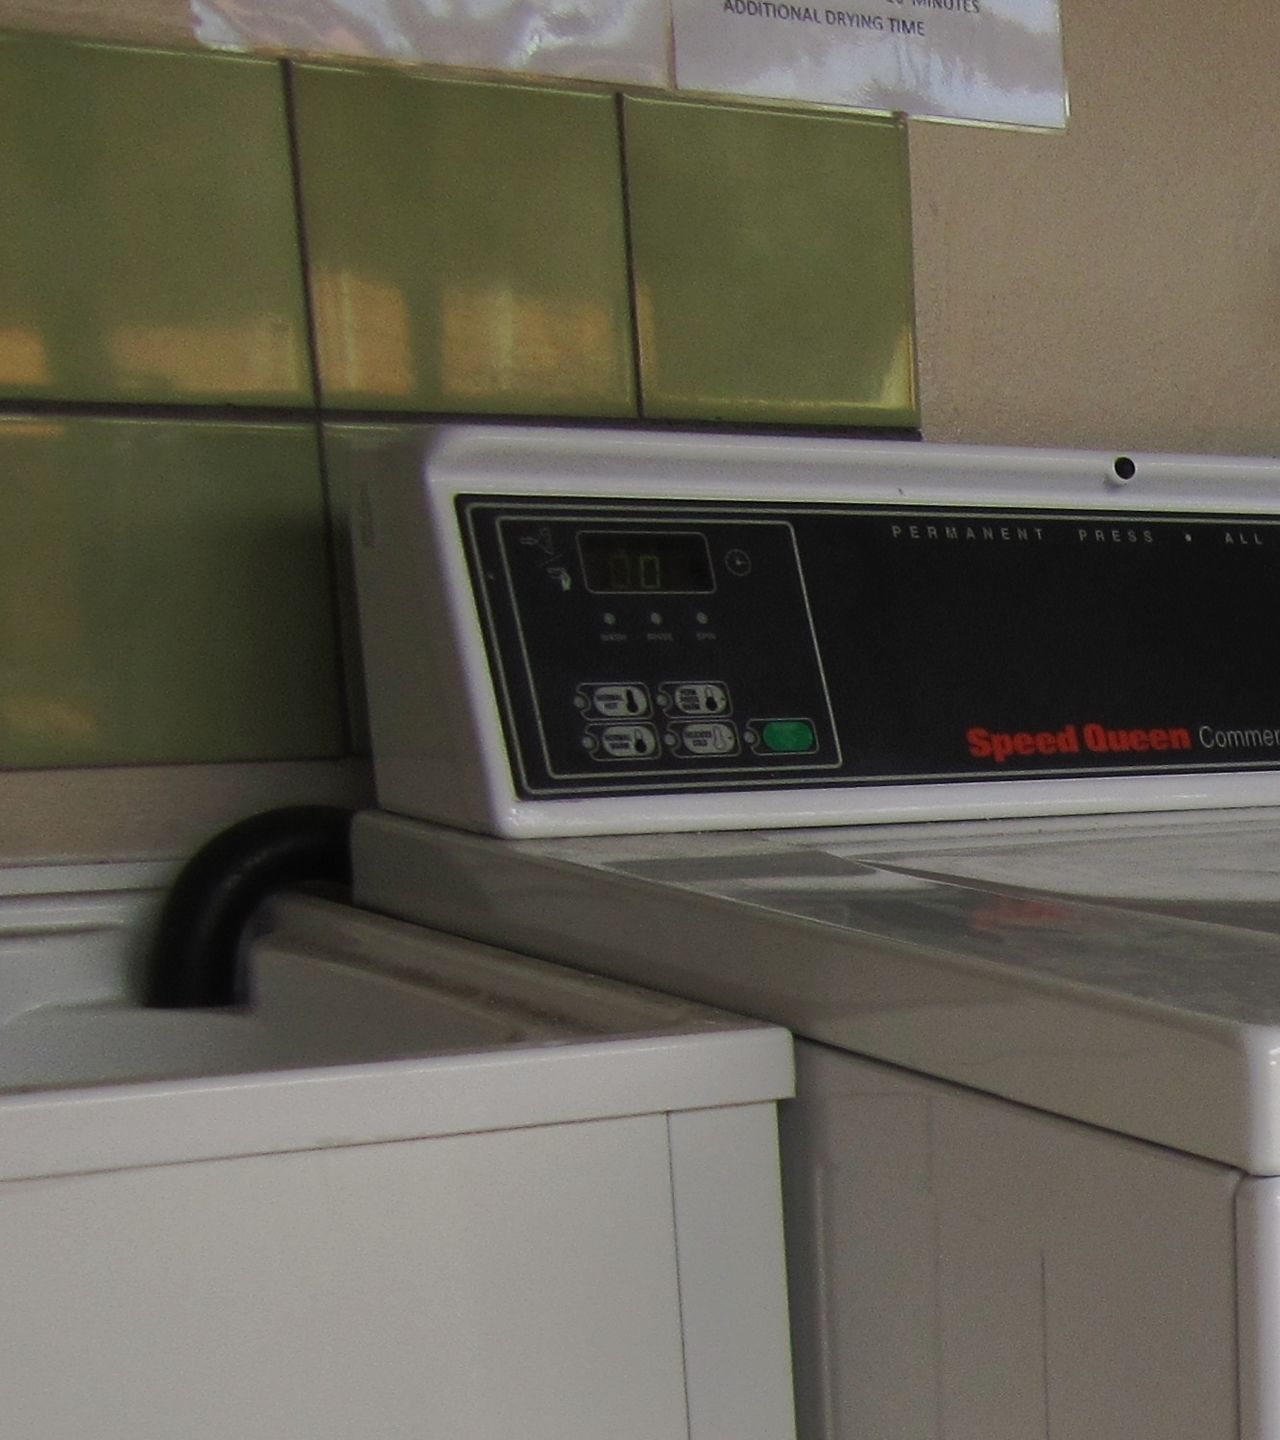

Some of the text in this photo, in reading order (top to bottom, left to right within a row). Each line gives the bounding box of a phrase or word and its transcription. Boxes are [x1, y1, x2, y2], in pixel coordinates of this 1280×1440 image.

[724, 0, 925, 36] ADDITIONAL DRYING TIME
[891, 525, 1043, 541] PERMANENT
[1078, 529, 1153, 543] PRESS
[1225, 532, 1264, 545] ALL
[966, 723, 1080, 763] Speed
[1083, 722, 1193, 752] Queen
